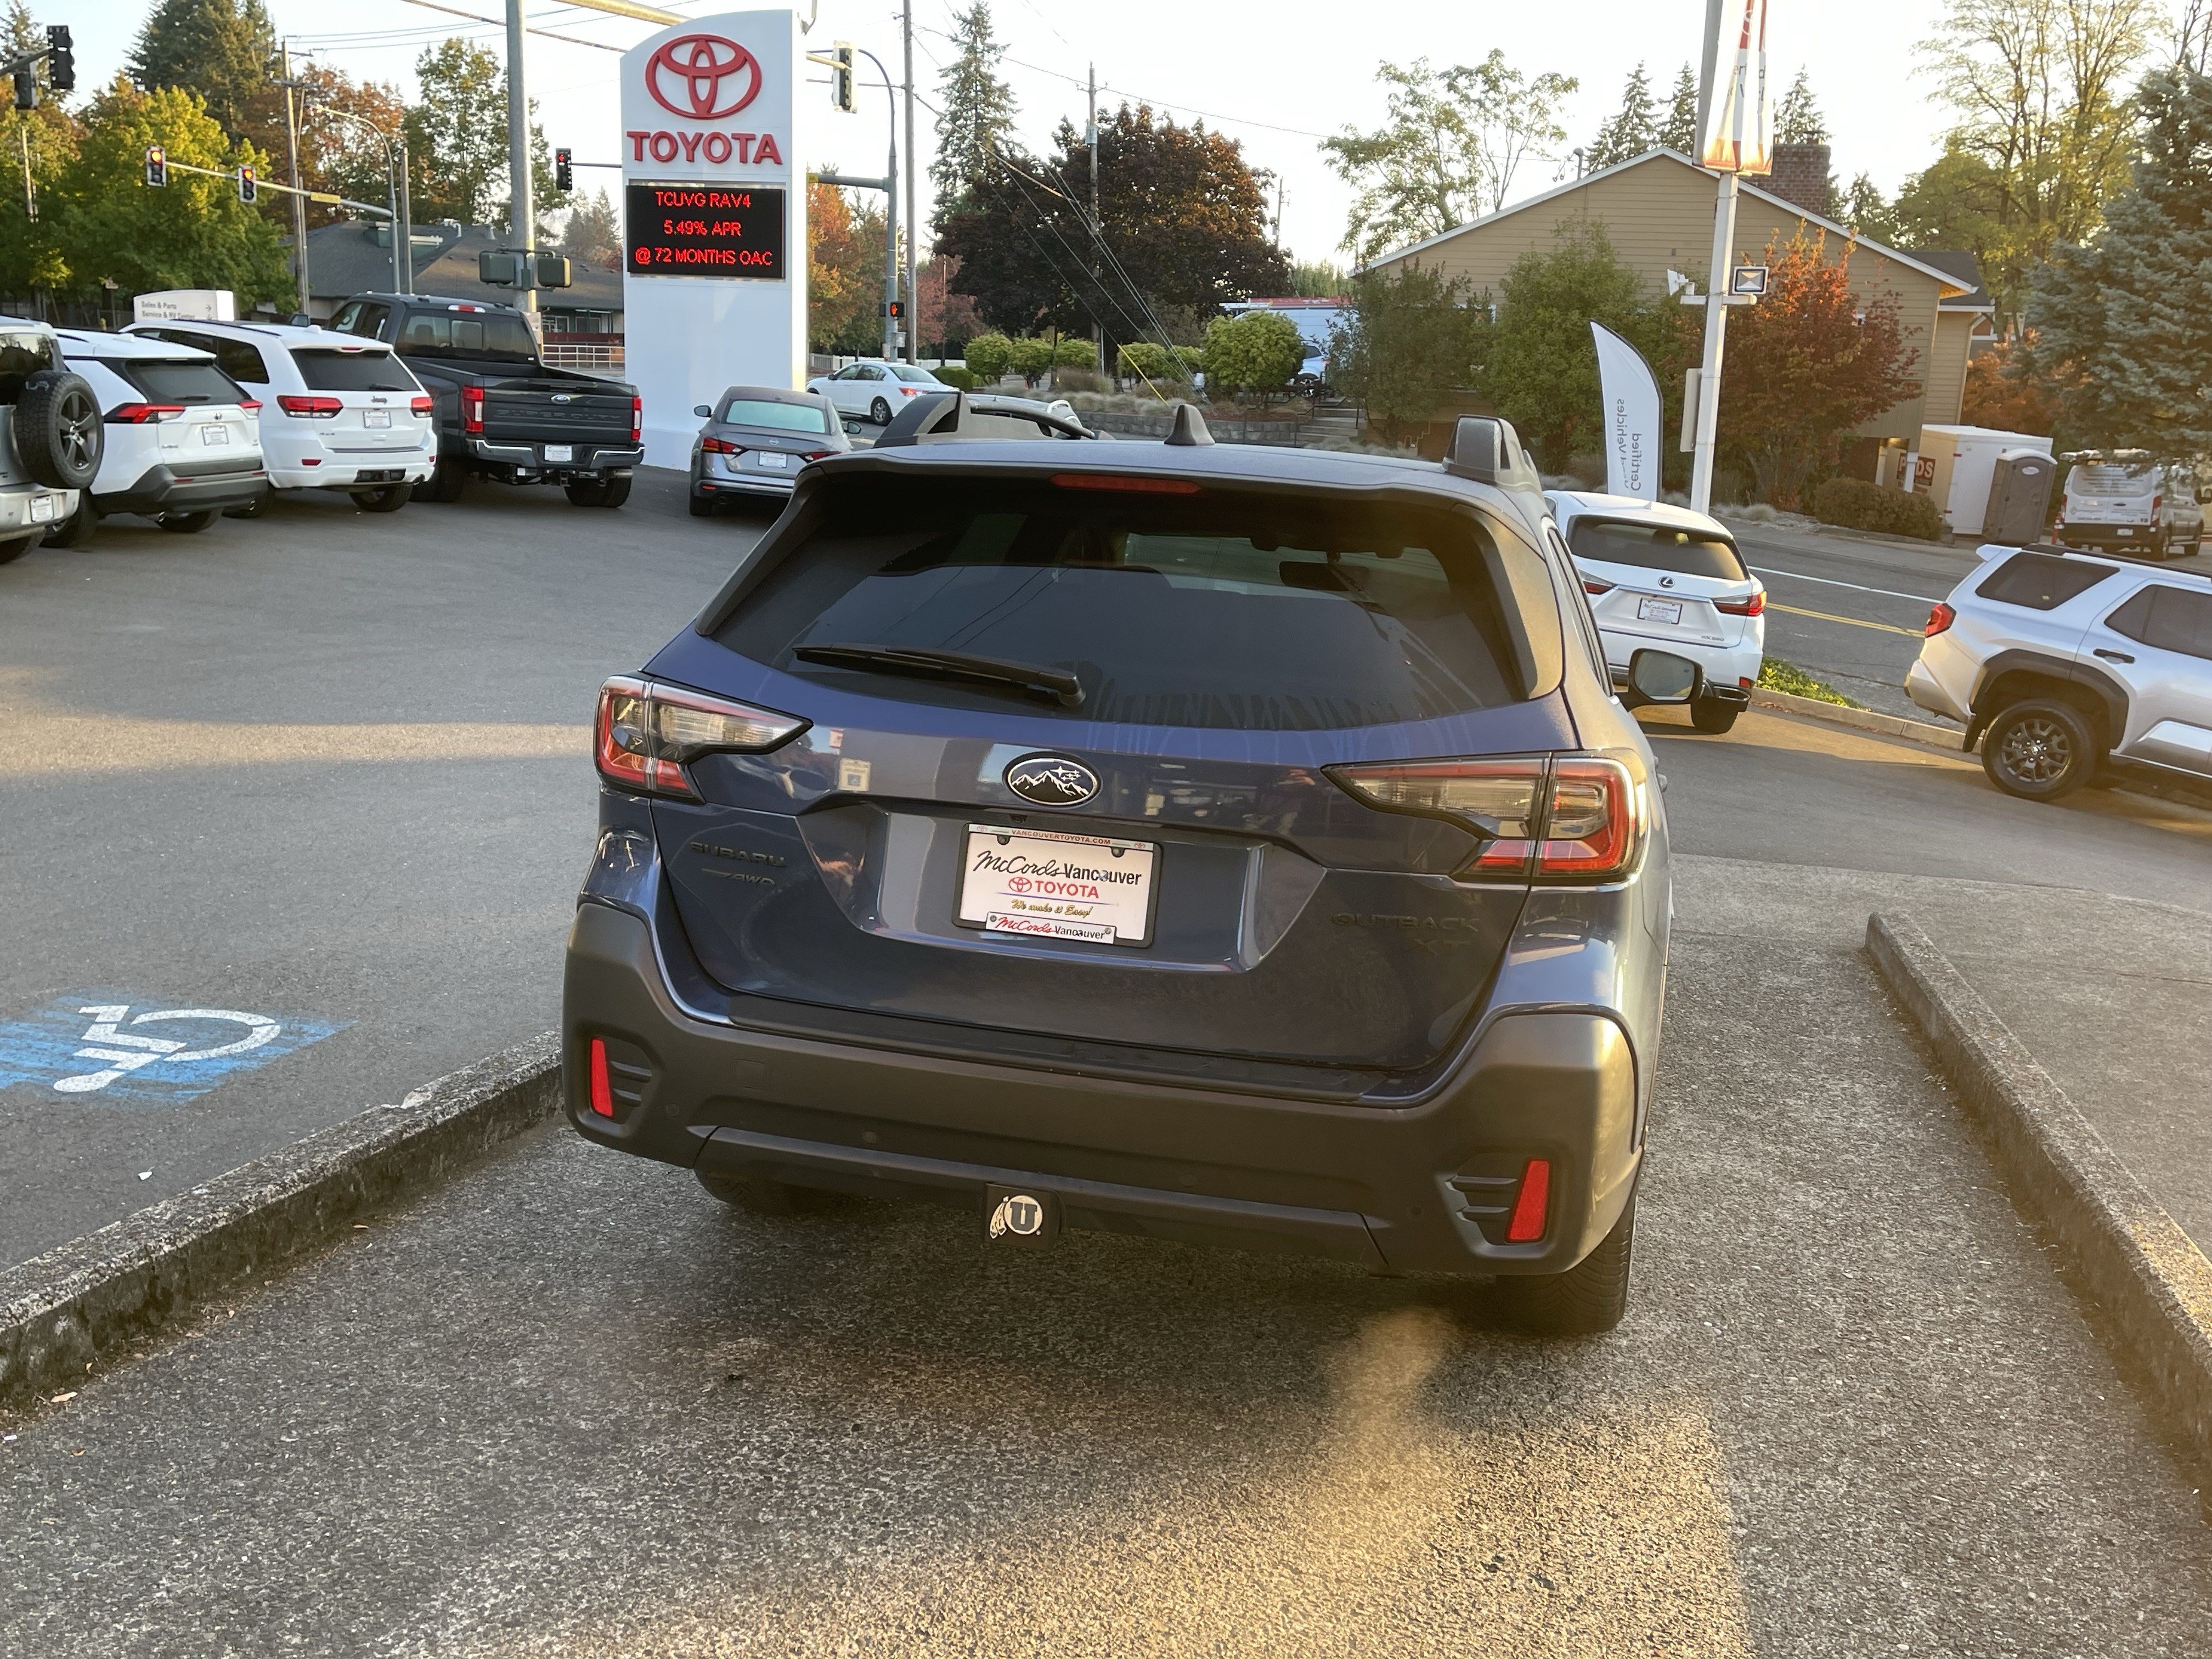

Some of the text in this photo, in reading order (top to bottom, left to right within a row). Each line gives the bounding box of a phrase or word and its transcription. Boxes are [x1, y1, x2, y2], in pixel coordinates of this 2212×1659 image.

[627, 131, 783, 165] TOYOTA
[709, 193, 752, 208] RAV4
[663, 219, 742, 236] 5.49% APR
[635, 246, 773, 266] @ 72 MONTHS OAC
[1899, 456, 1933, 478] PDS
[1011, 829, 1111, 845] VANCOUVERTOYOTA.COM
[690, 842, 786, 867] SUBARU
[1035, 880, 1099, 899] TOYOTA
[1012, 899, 1026, 910] We
[1028, 902, 1052, 913] make
[1064, 905, 1094, 919] Easy!
[1331, 912, 1481, 933] OUTBACK
